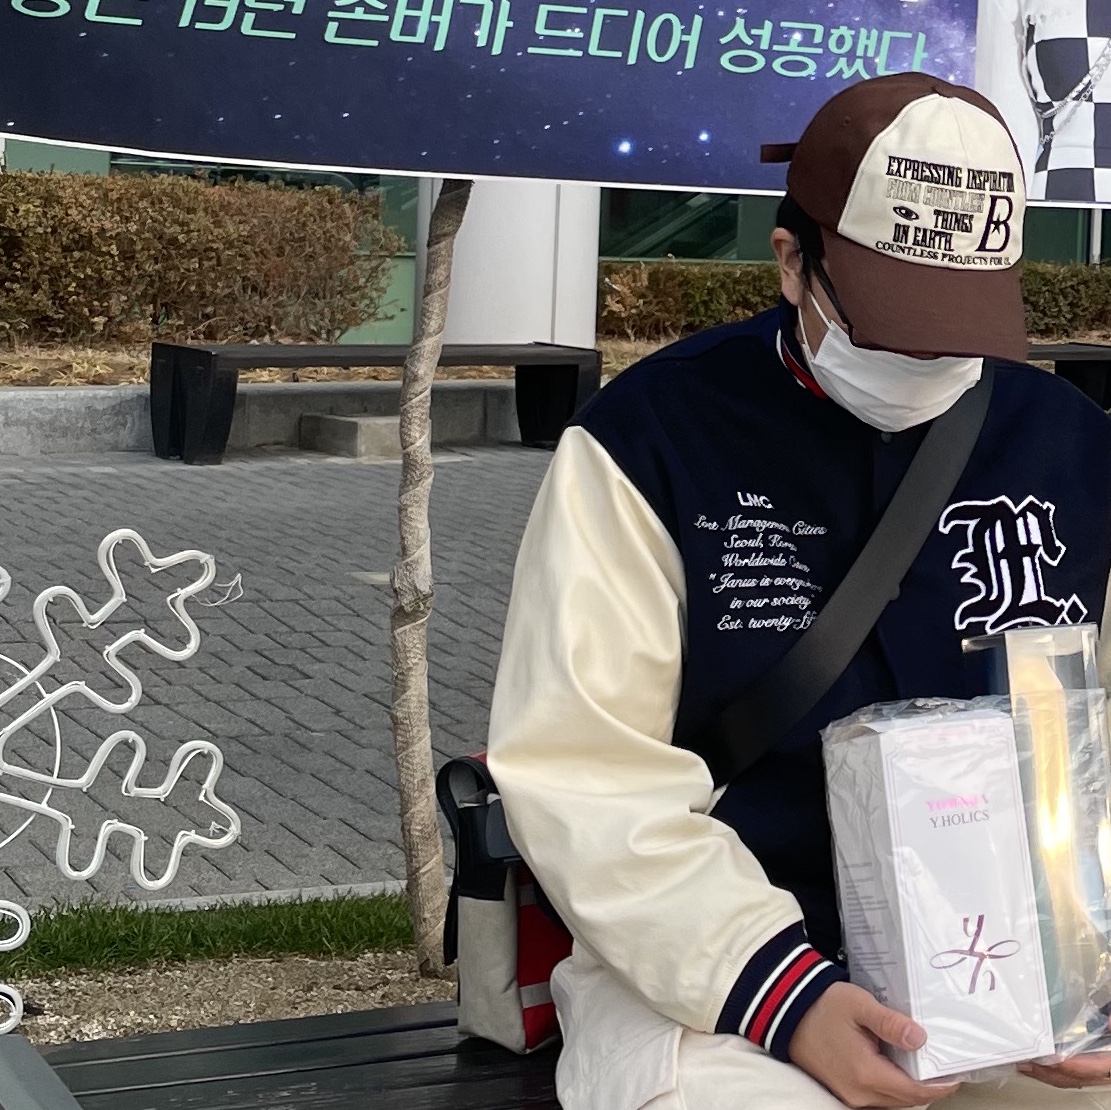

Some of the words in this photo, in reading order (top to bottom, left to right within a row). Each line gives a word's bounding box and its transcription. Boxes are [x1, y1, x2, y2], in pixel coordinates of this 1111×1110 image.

[325, 0, 514, 55] 존버가
[527, 4, 703, 69] 드디어
[719, 17, 929, 80] 성공했다
[886, 155, 963, 188] EXPRESSING
[933, 209, 975, 233] THINGS
[892, 222, 910, 245] ON
[912, 226, 955, 252] EARTH
[875, 240, 939, 261] COUNTLESS
[941, 252, 989, 267] PROJECTS
[737, 491, 775, 510] LMC
[721, 552, 788, 567] Worldwide
[759, 574, 773, 587] is
[729, 597, 745, 609] in
[745, 600, 769, 609] our
